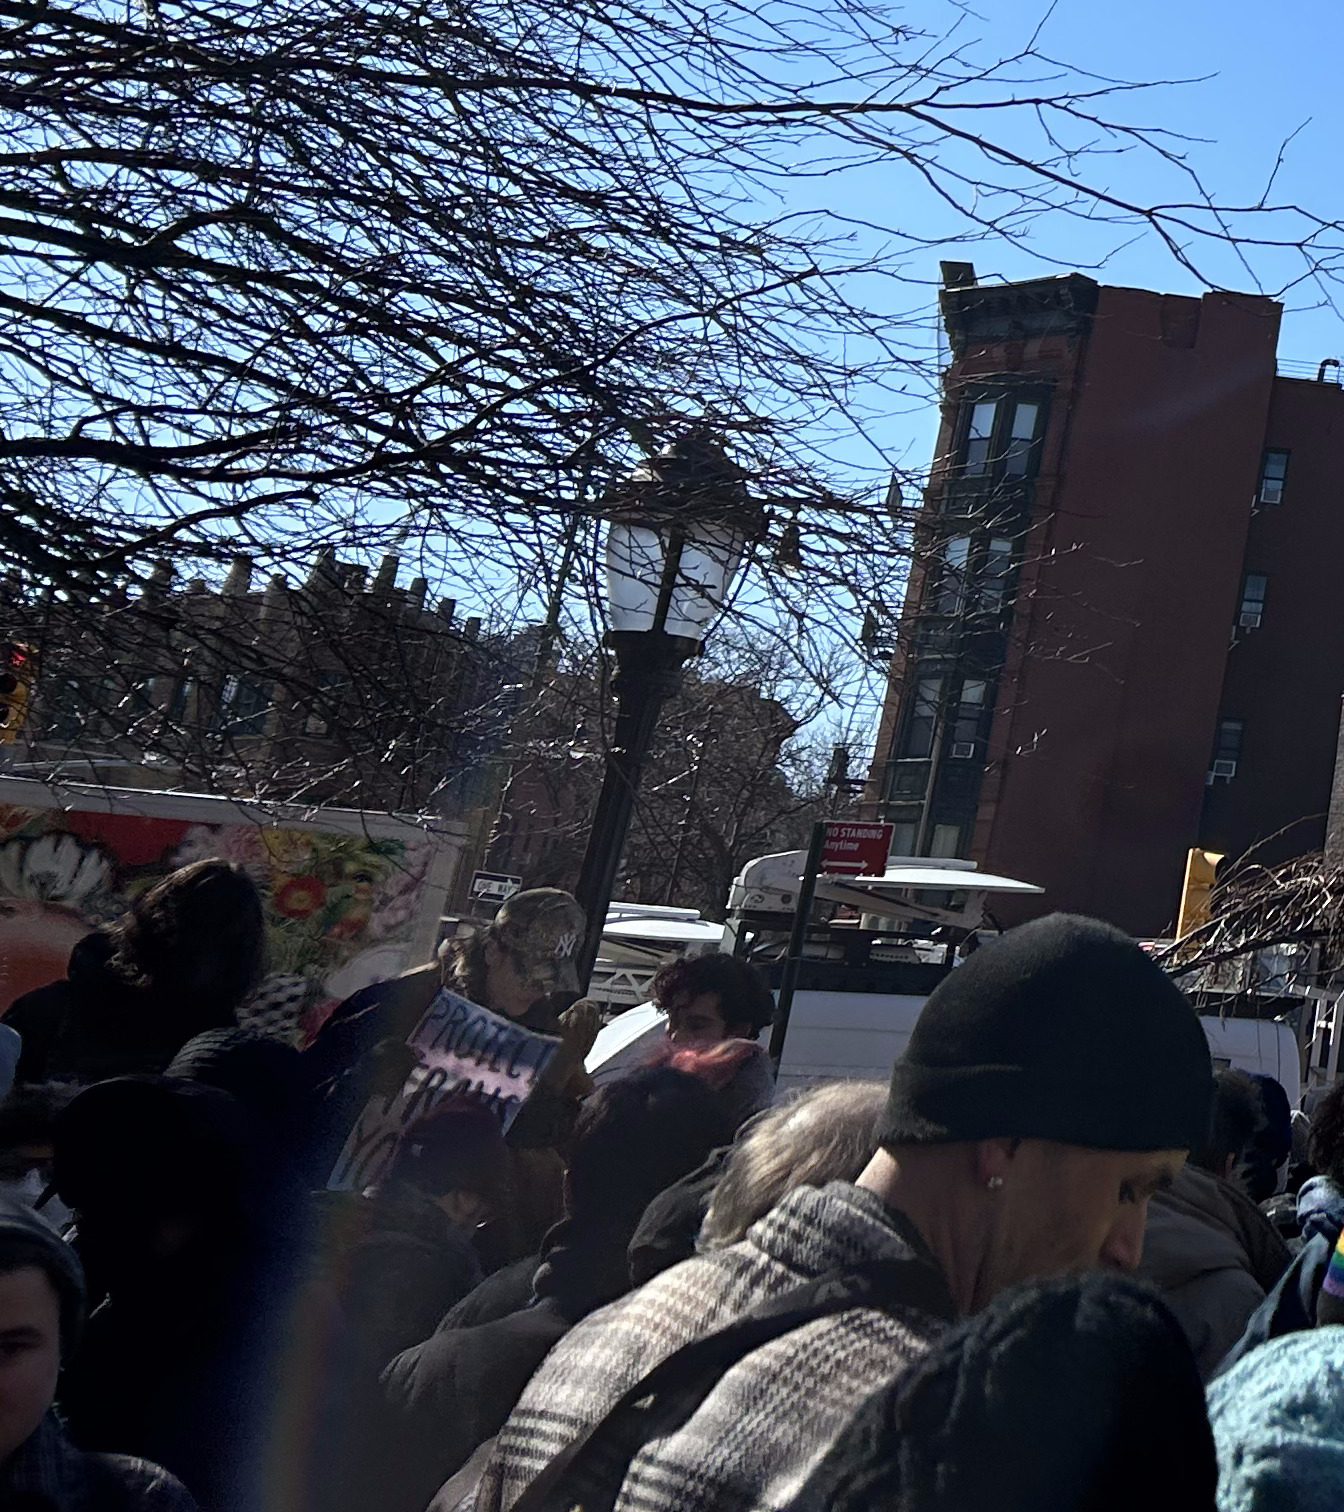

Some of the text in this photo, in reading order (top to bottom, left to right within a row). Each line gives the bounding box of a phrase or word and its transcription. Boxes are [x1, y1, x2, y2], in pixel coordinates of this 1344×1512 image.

[826, 827, 884, 840] NO STANDING
[824, 839, 860, 852] Anytime
